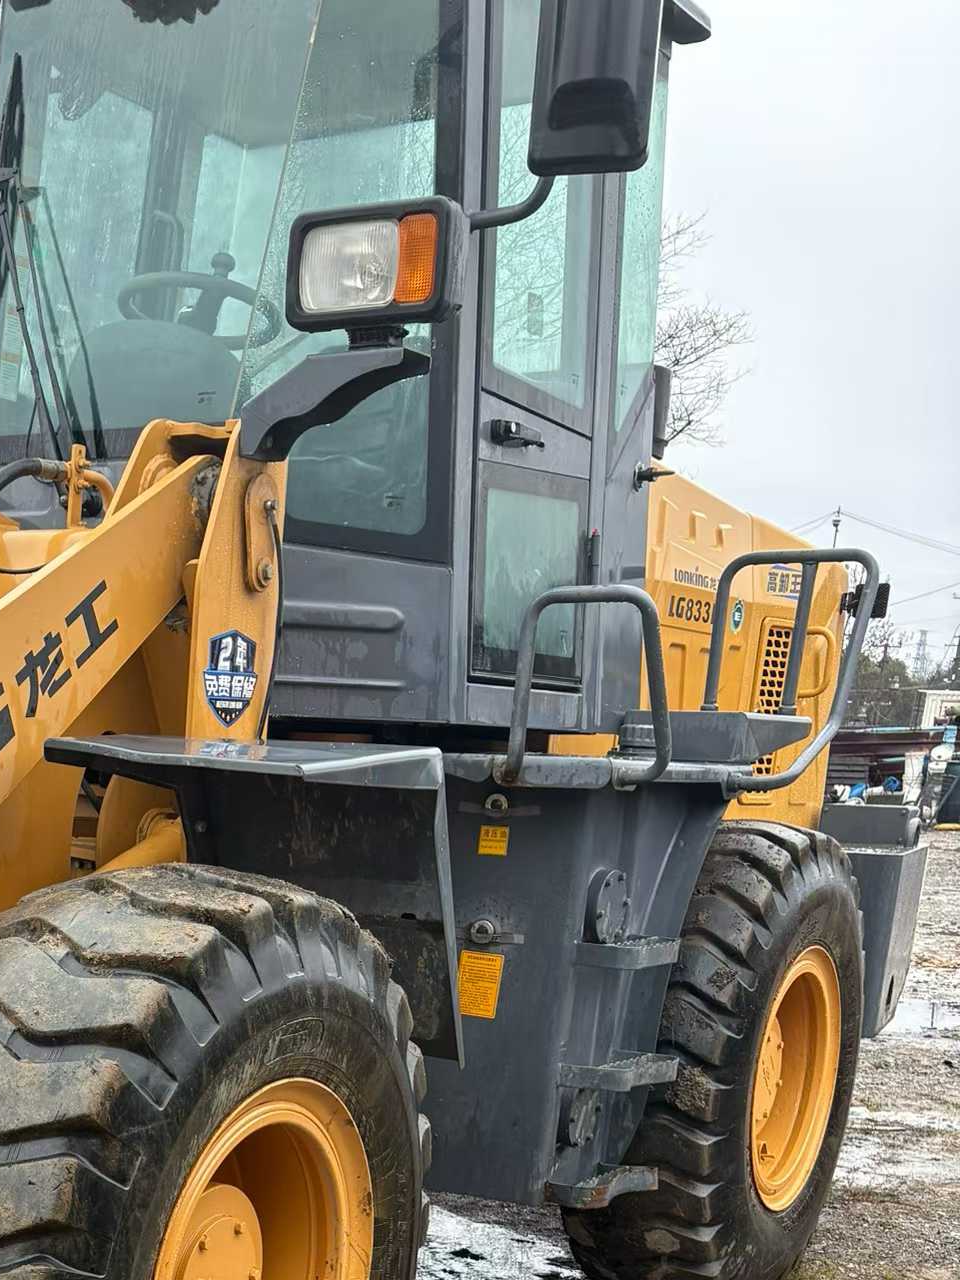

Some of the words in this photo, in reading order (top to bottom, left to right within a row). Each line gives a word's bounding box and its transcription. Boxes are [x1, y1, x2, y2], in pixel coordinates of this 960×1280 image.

[668, 595, 713, 624] LG833
[15, 579, 120, 718] 龙工
[218, 636, 247, 672] 2年
[204, 674, 257, 698] 免费保修
